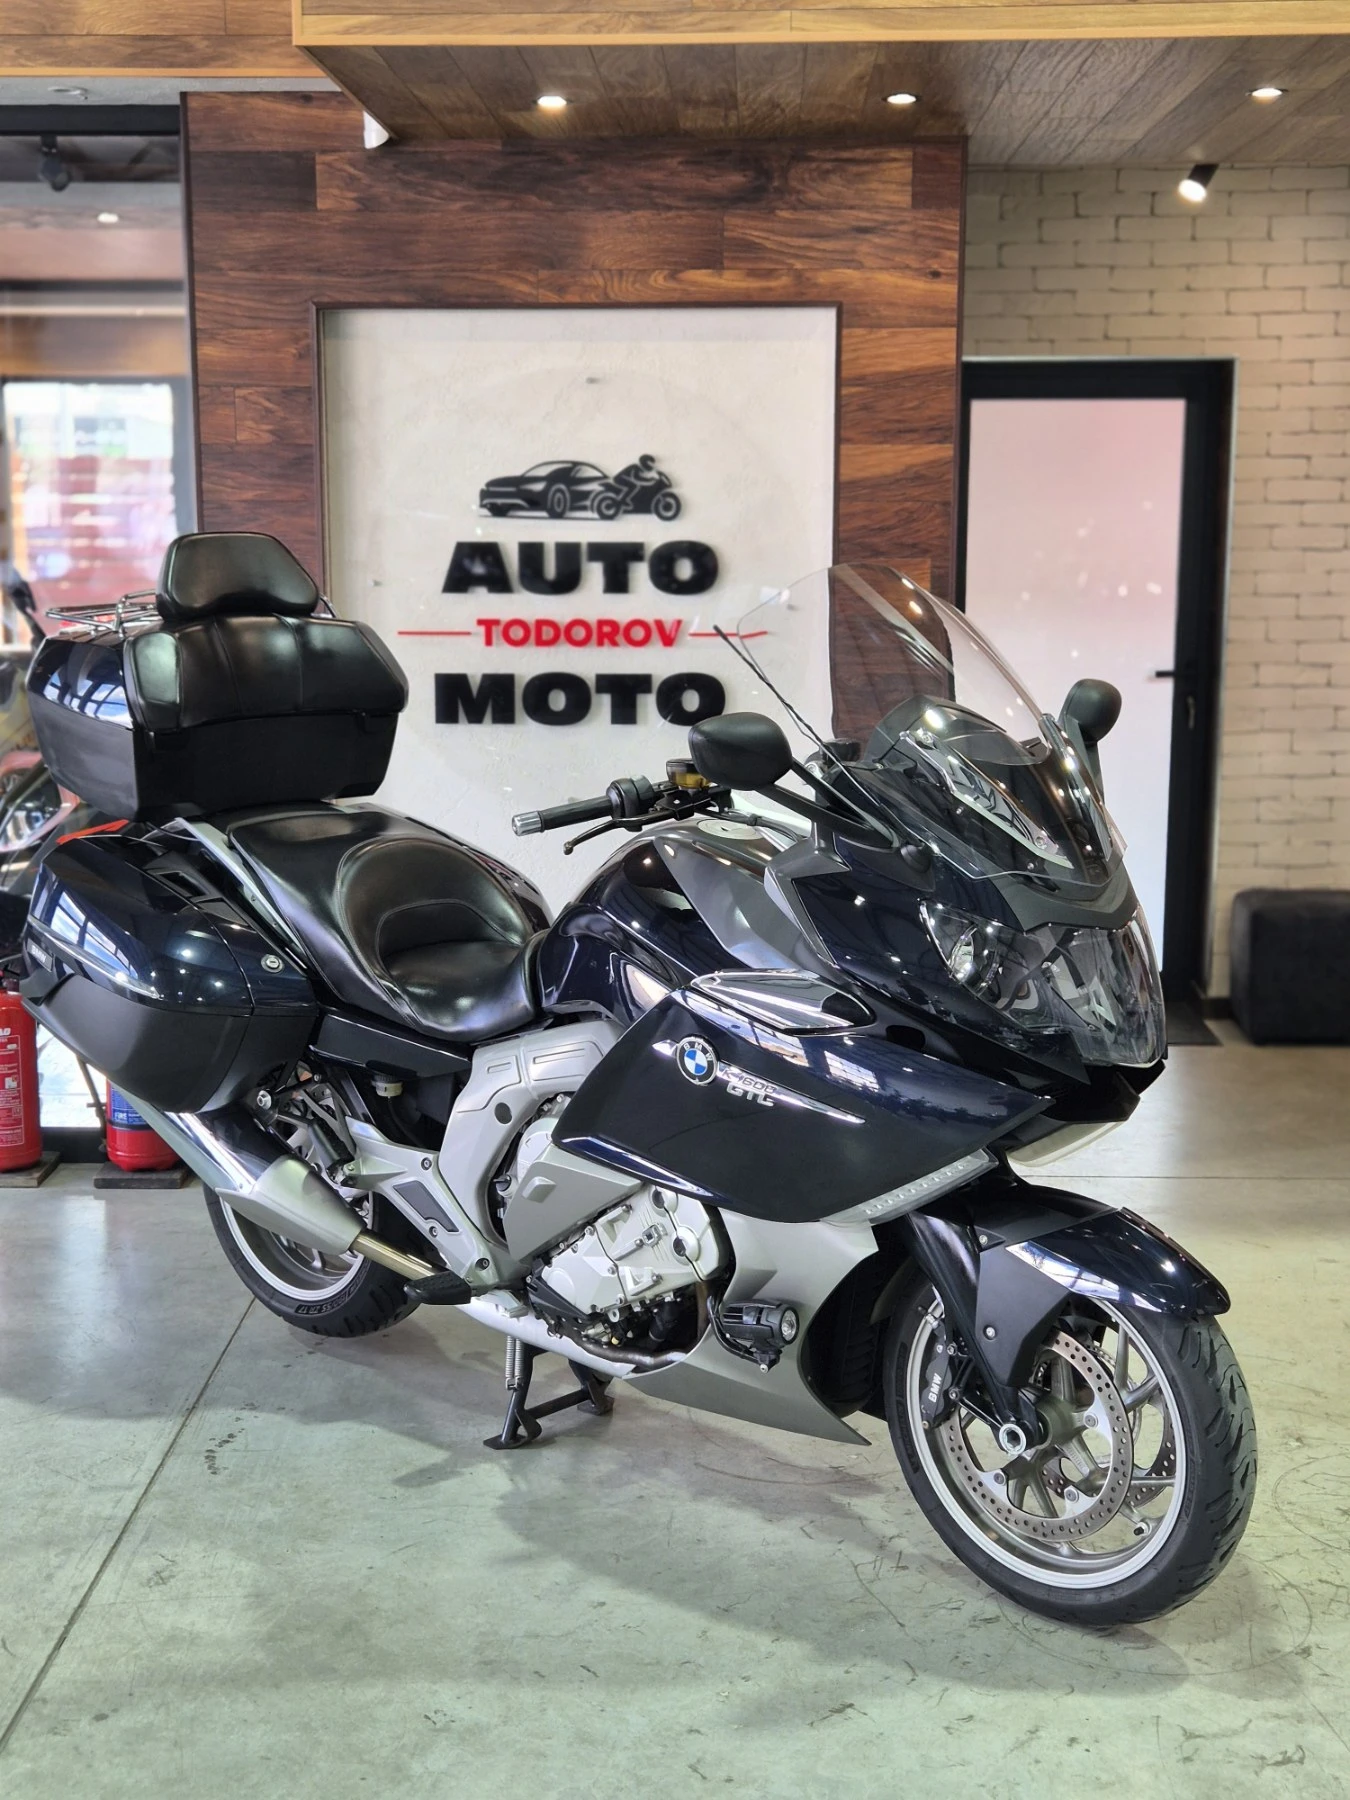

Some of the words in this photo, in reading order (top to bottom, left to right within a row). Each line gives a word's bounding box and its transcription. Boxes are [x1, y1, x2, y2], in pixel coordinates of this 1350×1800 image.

[441, 540, 719, 595] AUTO
[476, 618, 683, 648] TODOROV
[434, 671, 726, 726] MOTO
[683, 1041, 714, 1061] BMW
[927, 1372, 942, 1403] BMW
